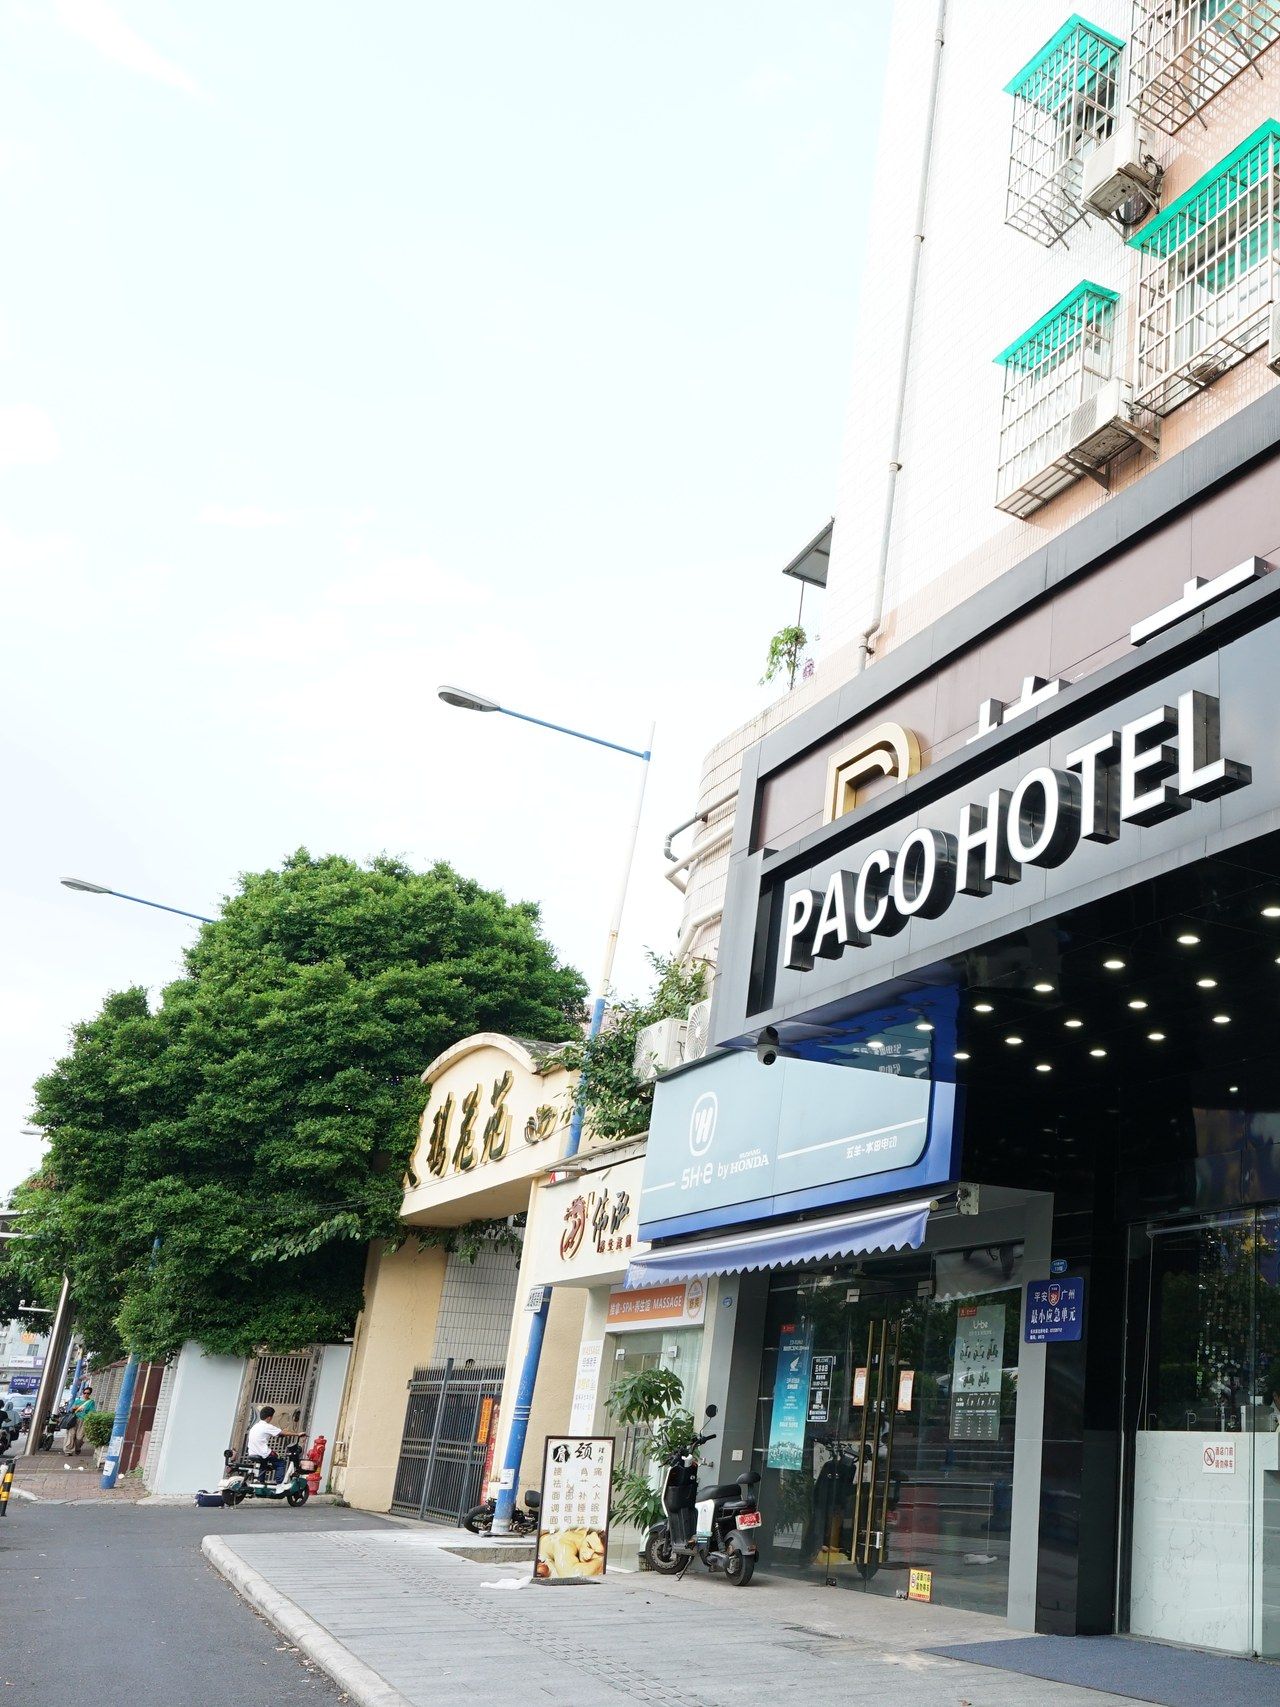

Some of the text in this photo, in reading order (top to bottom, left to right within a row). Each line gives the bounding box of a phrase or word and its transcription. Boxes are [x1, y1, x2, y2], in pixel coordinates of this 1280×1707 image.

[783, 690, 1251, 971] PACO HOTEL
[846, 1136, 898, 1159] 五羊-本田电动
[717, 1162, 730, 1179] by
[730, 1154, 769, 1174] HONDA
[652, 1295, 682, 1310] MASSAGE
[1034, 1289, 1075, 1302] 平安 广州
[1031, 1307, 1076, 1324] 最小应急单元
[1215, 1460, 1233, 1468] 请勿停车
